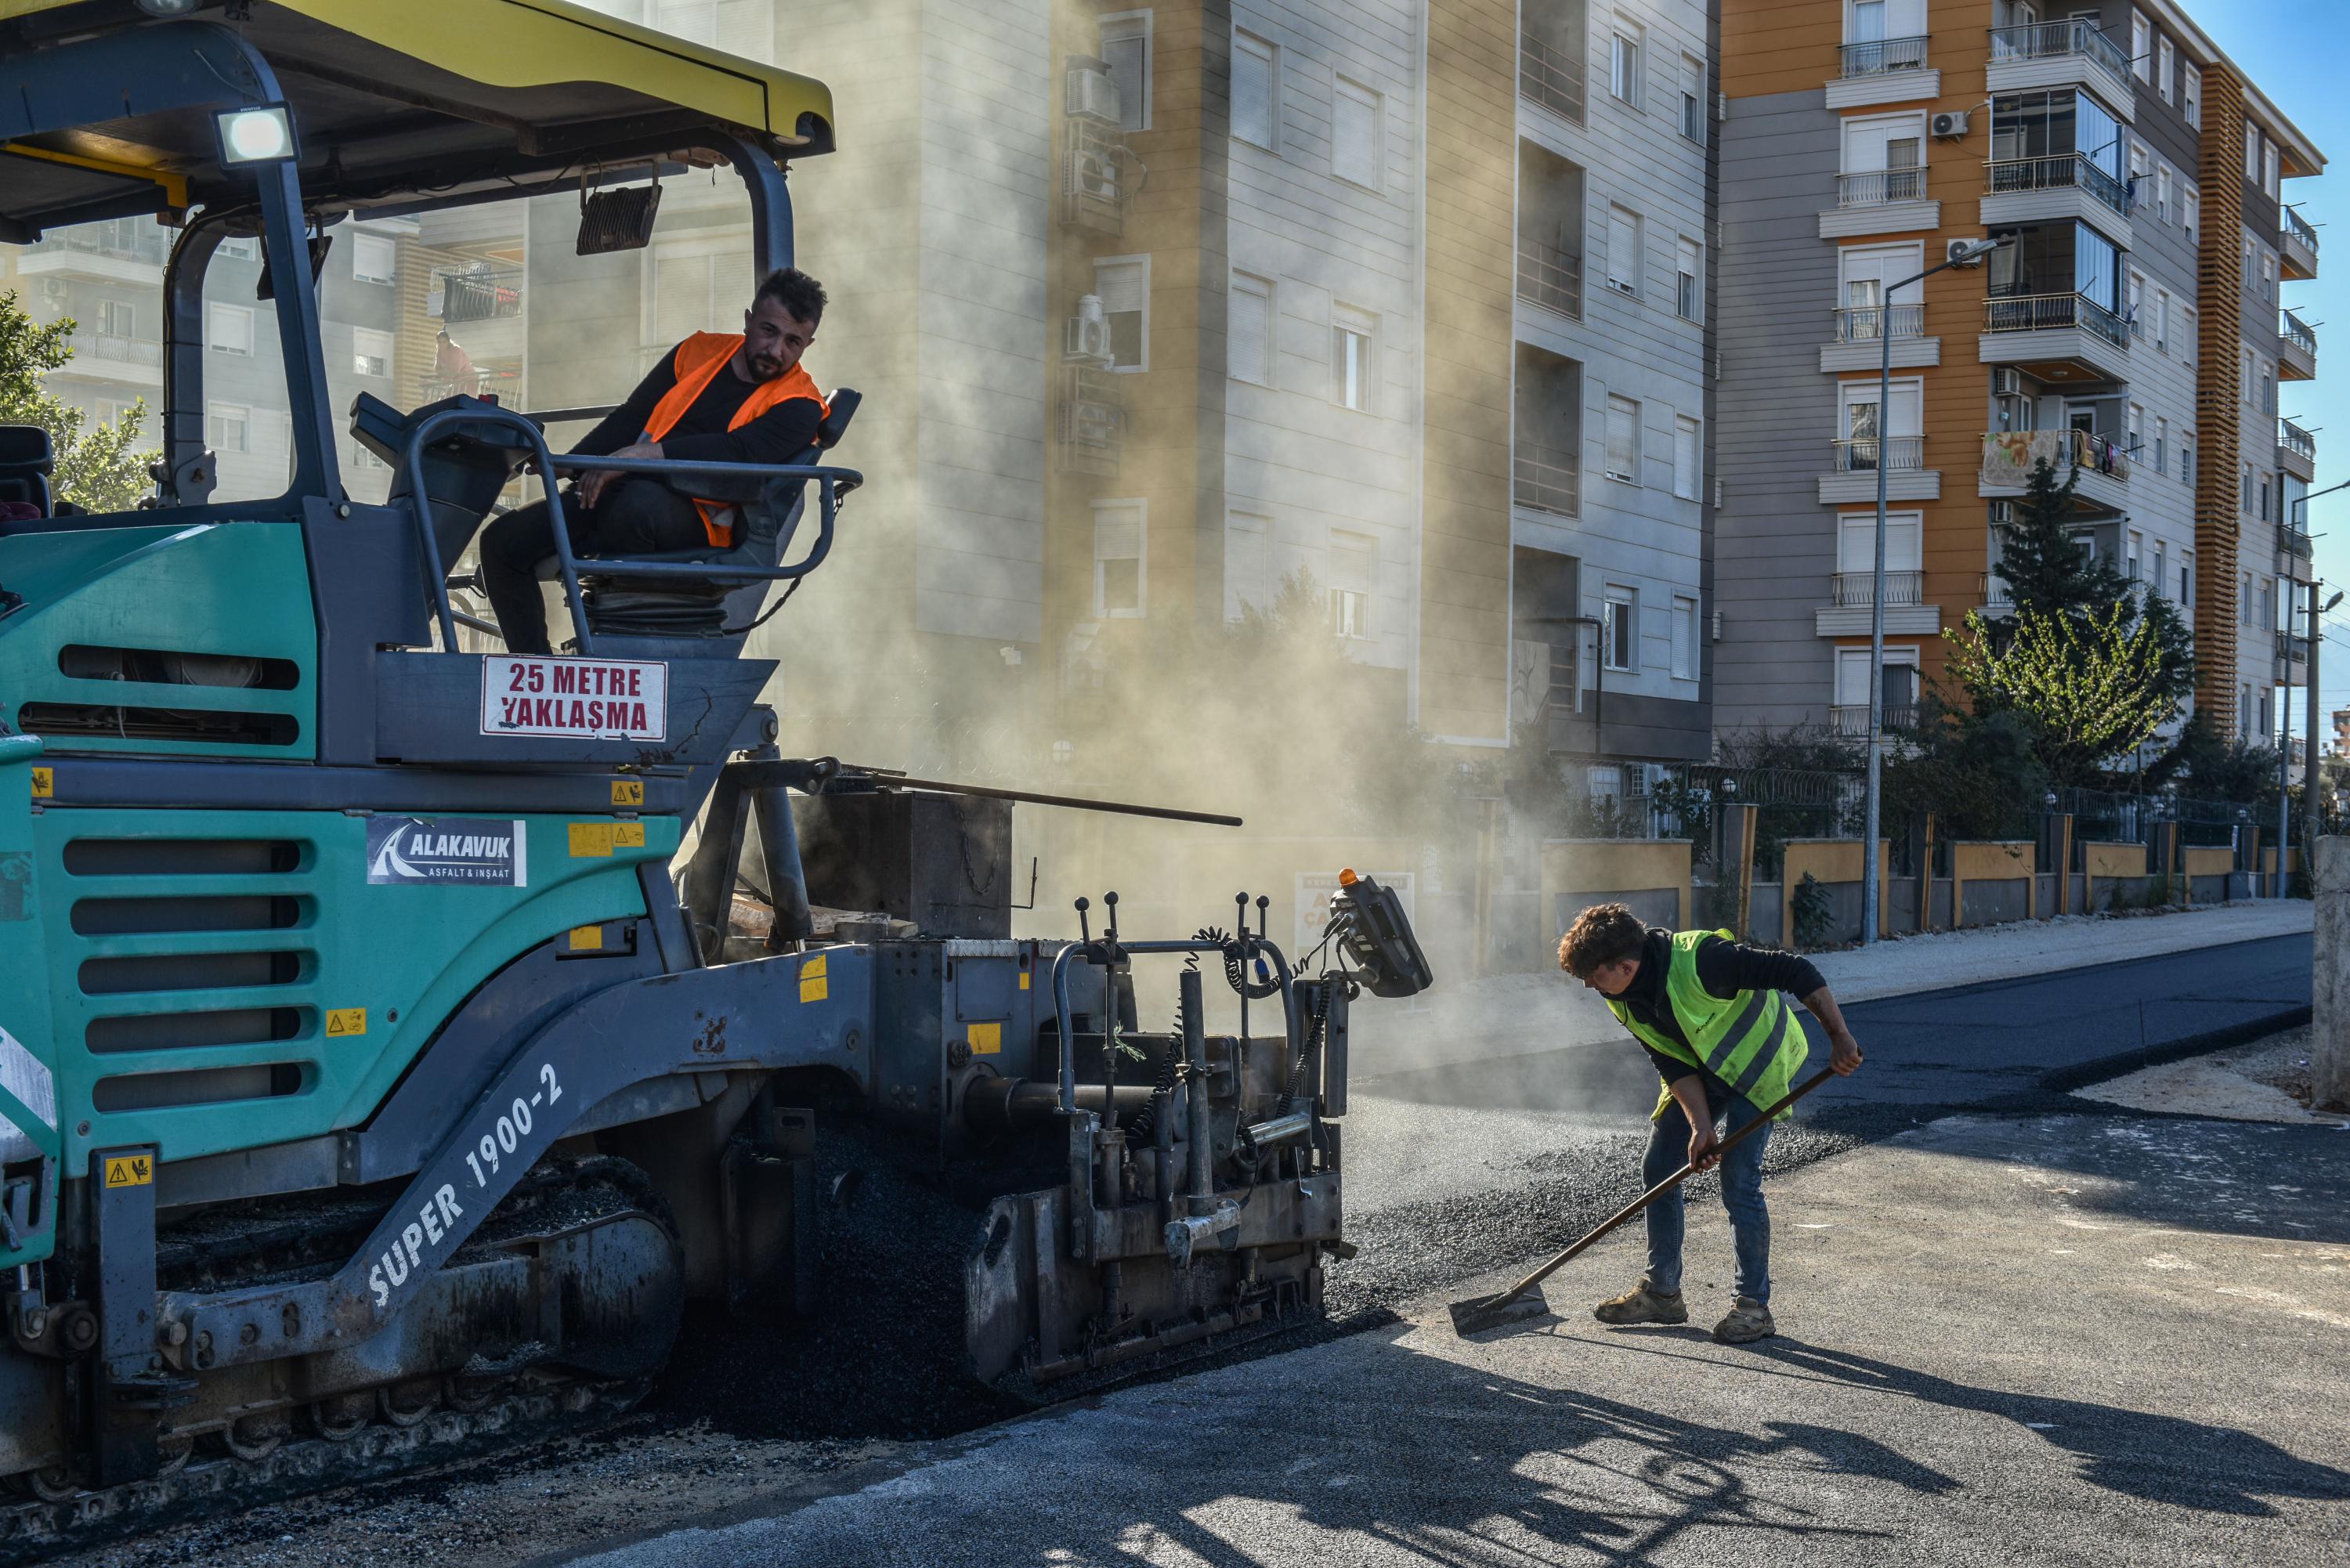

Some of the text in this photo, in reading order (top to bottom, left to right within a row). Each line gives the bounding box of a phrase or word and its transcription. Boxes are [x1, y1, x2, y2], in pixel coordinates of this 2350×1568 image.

[510, 663, 641, 696] 25 METRE
[501, 697, 647, 732] YAKLAŞMA
[410, 833, 511, 858] ALAKAVUK
[428, 868, 465, 877] ASFALT
[369, 1064, 562, 1308] SUPER 1900-2
